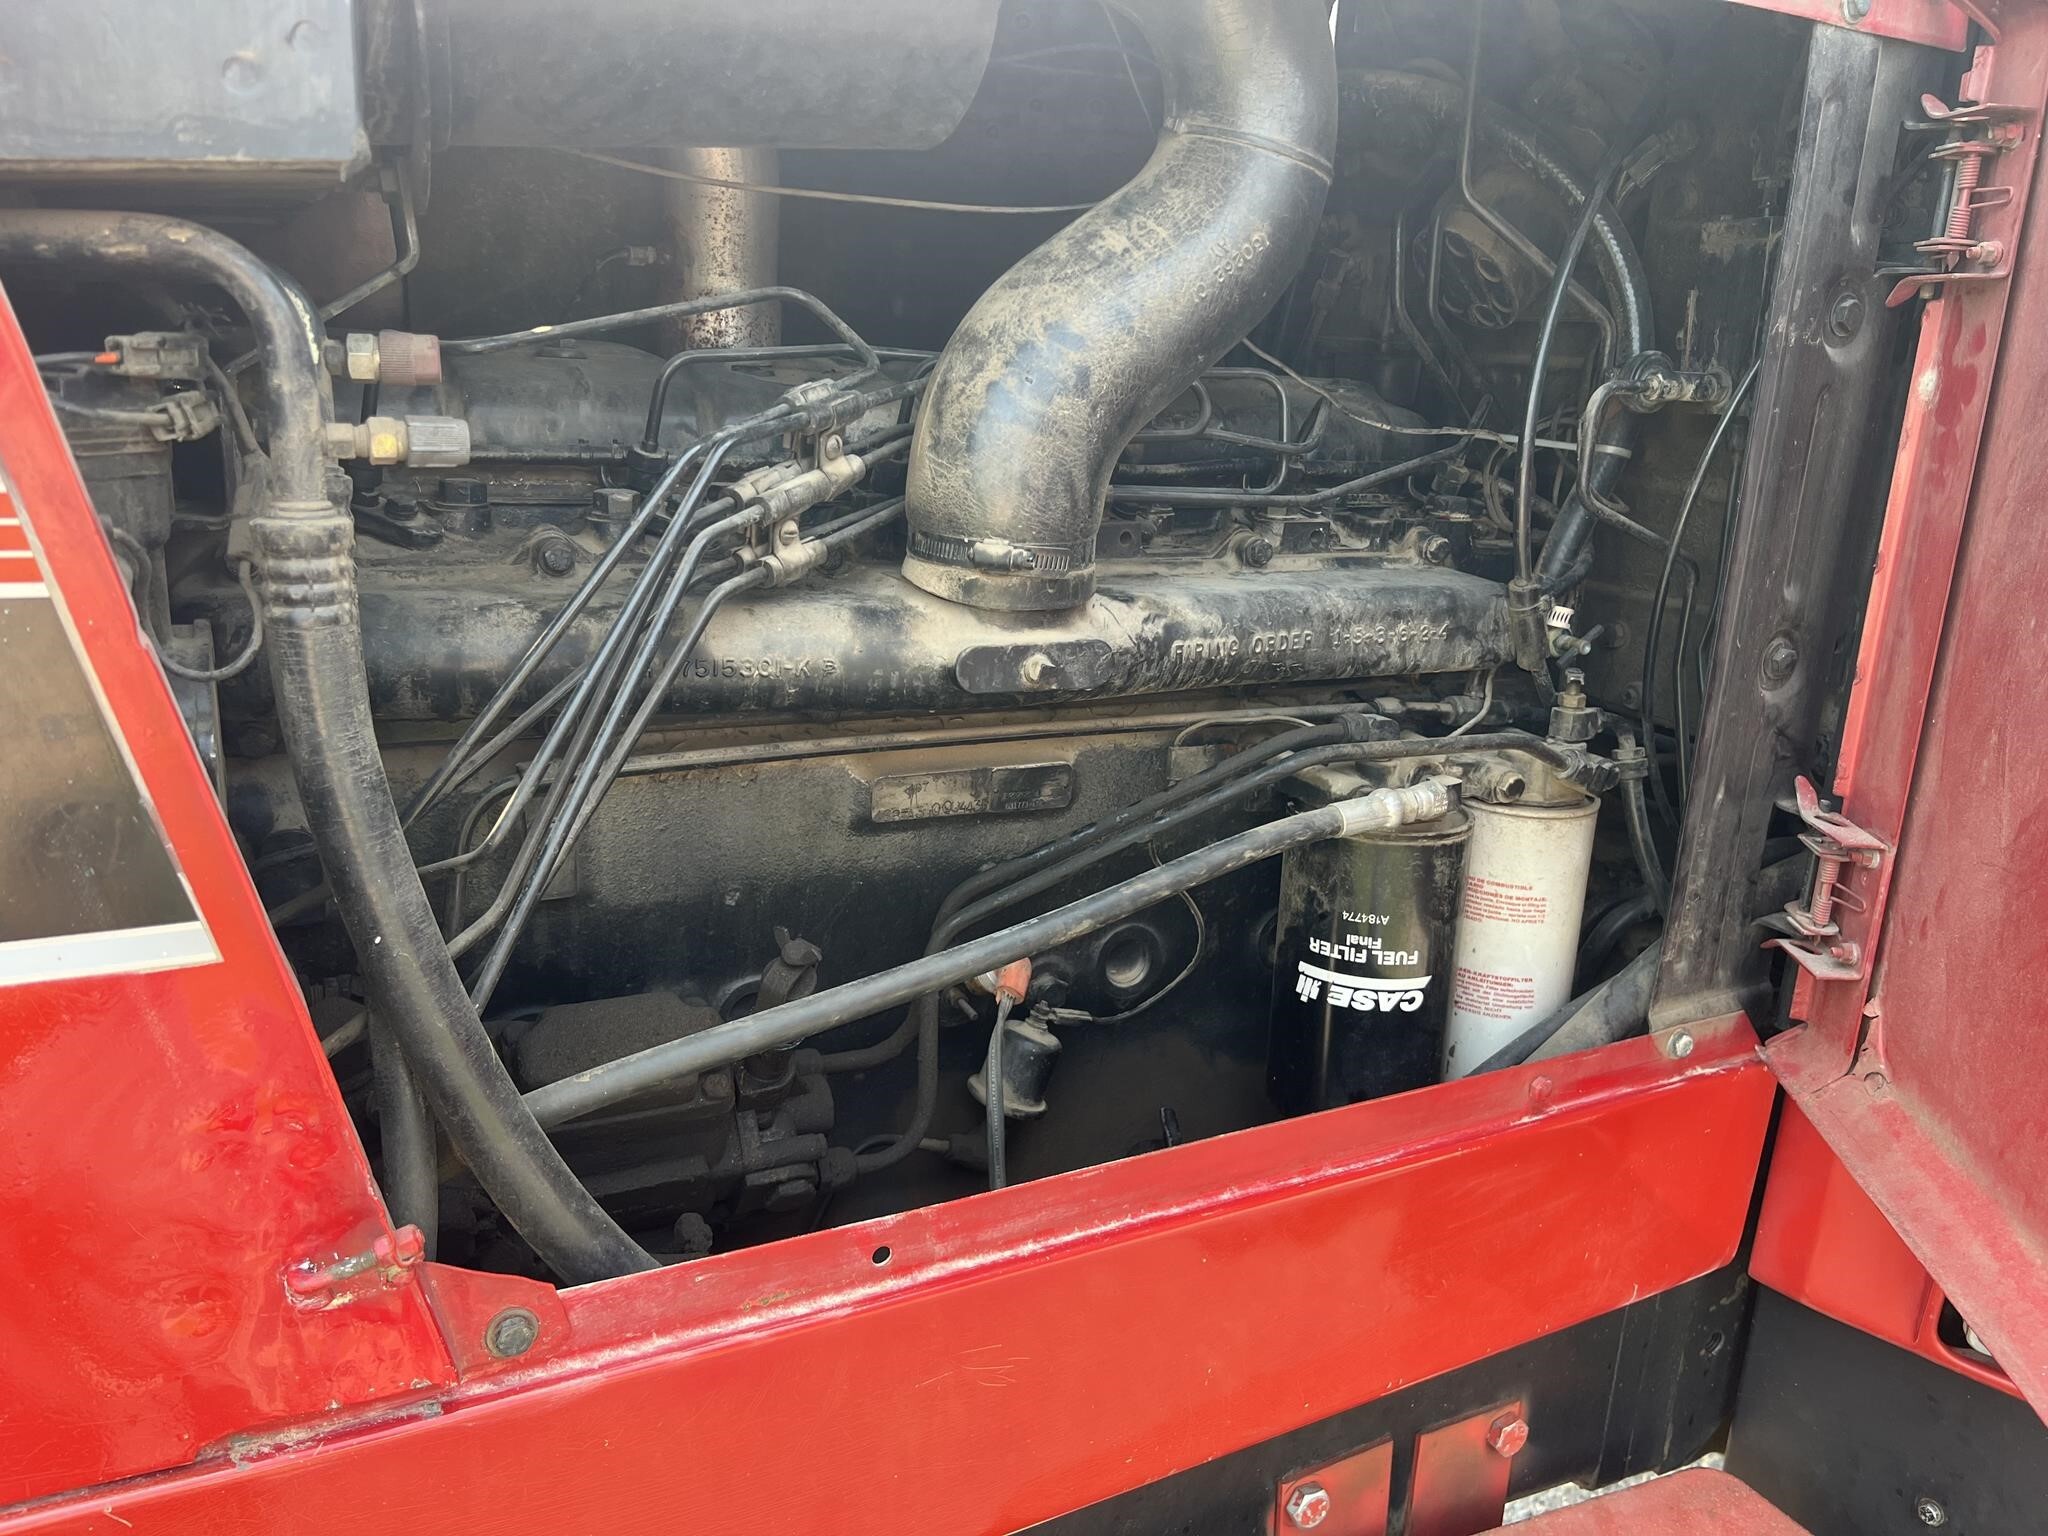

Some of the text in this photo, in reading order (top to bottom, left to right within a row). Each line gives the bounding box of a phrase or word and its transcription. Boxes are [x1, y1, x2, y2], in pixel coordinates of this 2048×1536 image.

[1171, 635, 1240, 661] FIRING
[1253, 630, 1313, 653] ORDER
[1486, 879, 1533, 891] COMBUSTIBLE
[1342, 910, 1390, 926] A184774
[1309, 936, 1419, 966] FUEL FILTER
[1346, 933, 1382, 950] Final
[1326, 984, 1424, 1012] CASE
